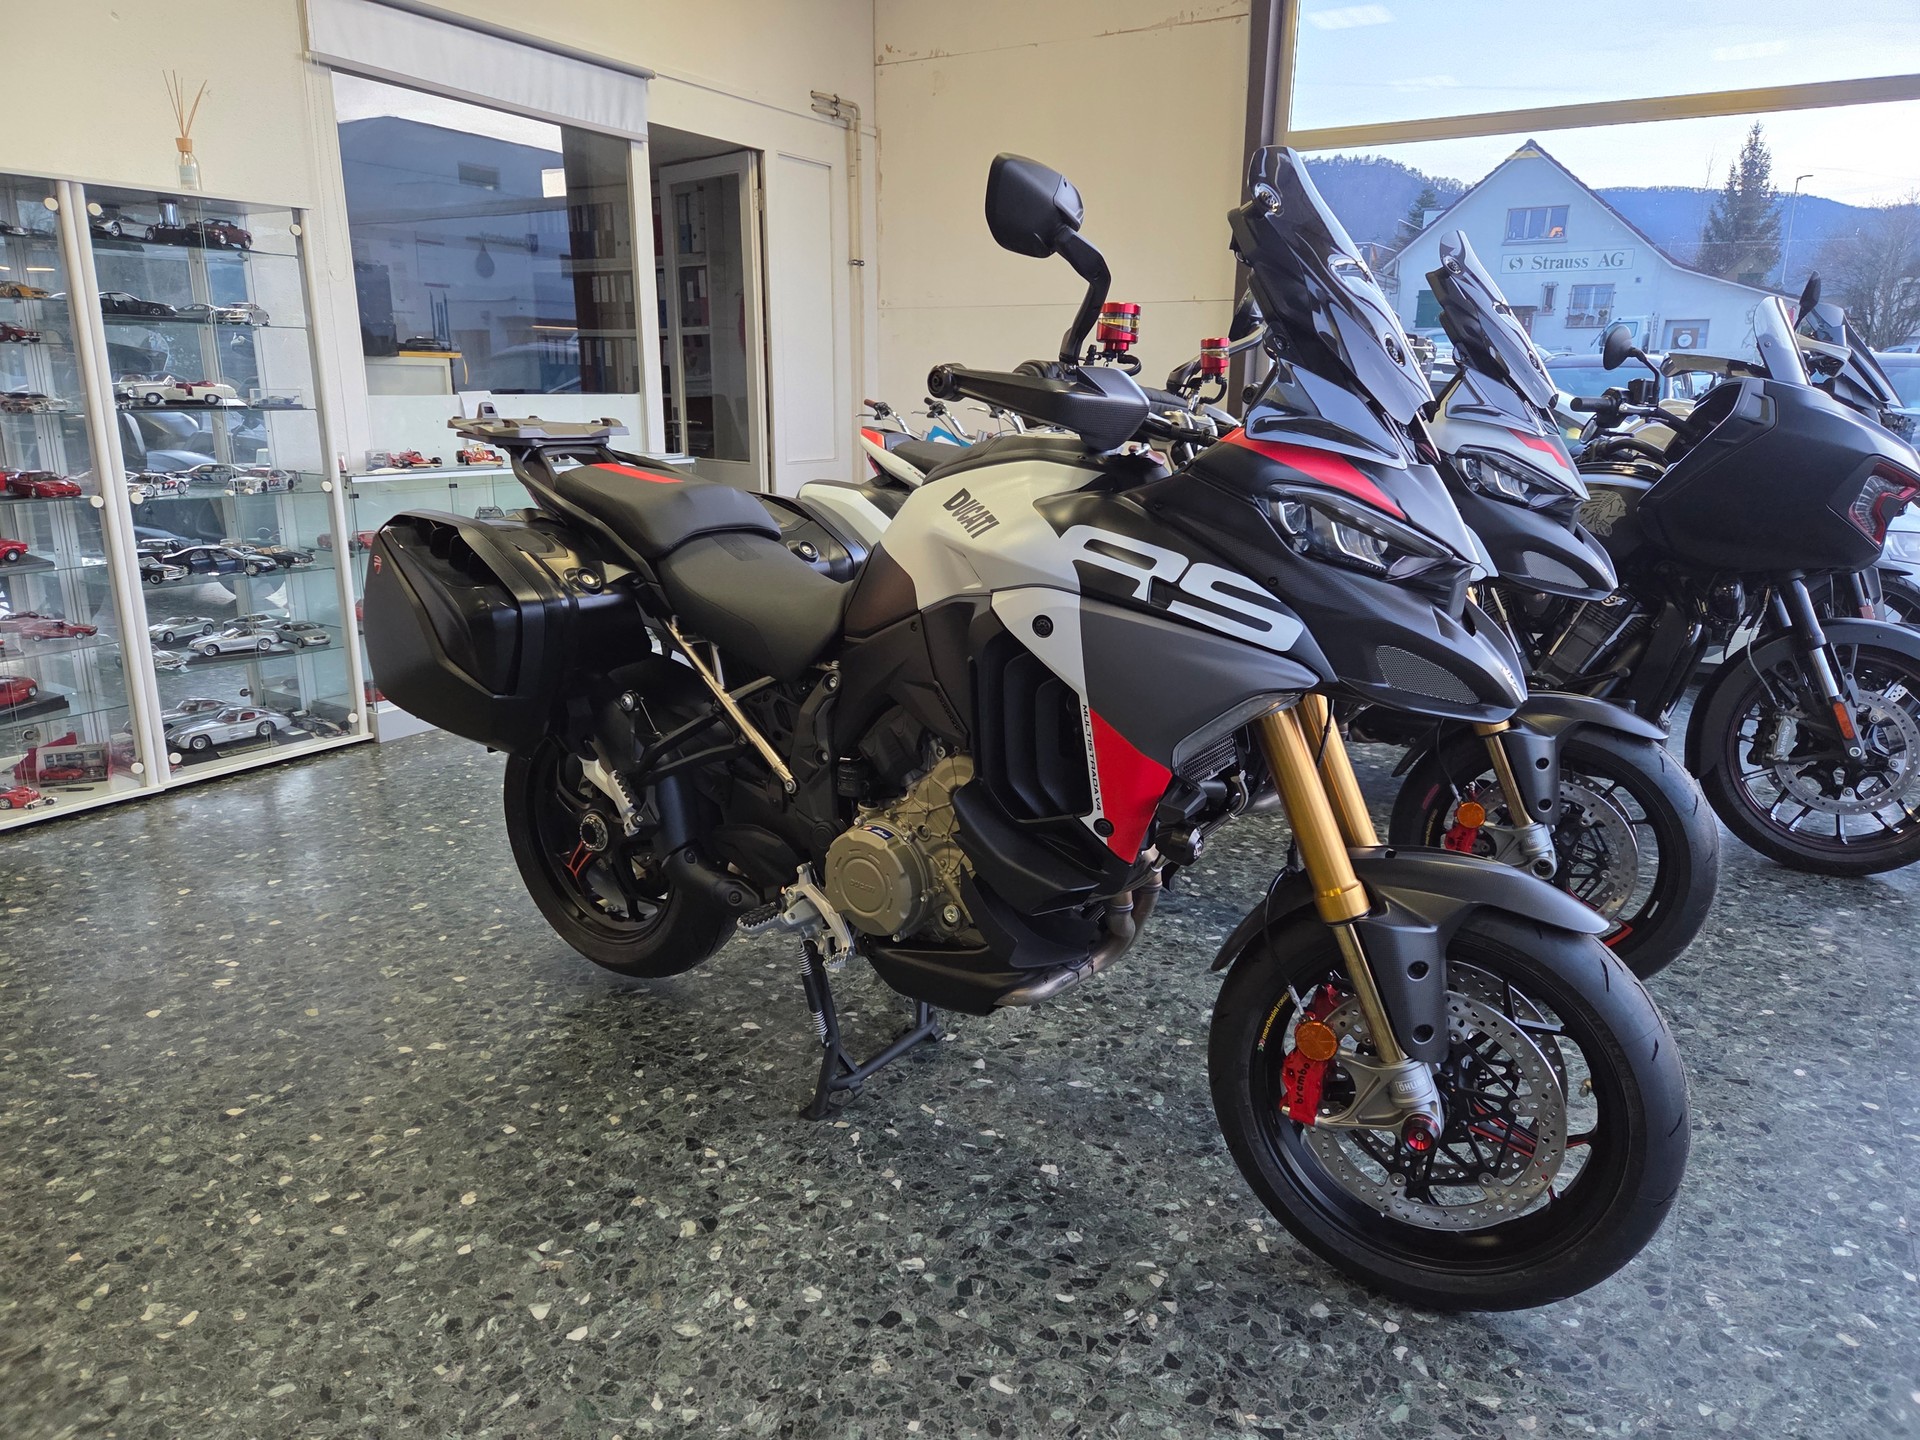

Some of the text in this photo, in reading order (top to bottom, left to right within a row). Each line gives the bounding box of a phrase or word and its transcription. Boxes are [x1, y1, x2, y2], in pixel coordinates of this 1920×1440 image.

[1531, 251, 1625, 270] Strauss AG
[942, 487, 1000, 539] DUCATI
[1055, 524, 1303, 652] RS
[1082, 704, 1102, 811] MULTISTRADA V4
[1777, 725, 1791, 753] brembo
[1262, 1006, 1280, 1040] marchesini
[1294, 1061, 1311, 1105] brembo
